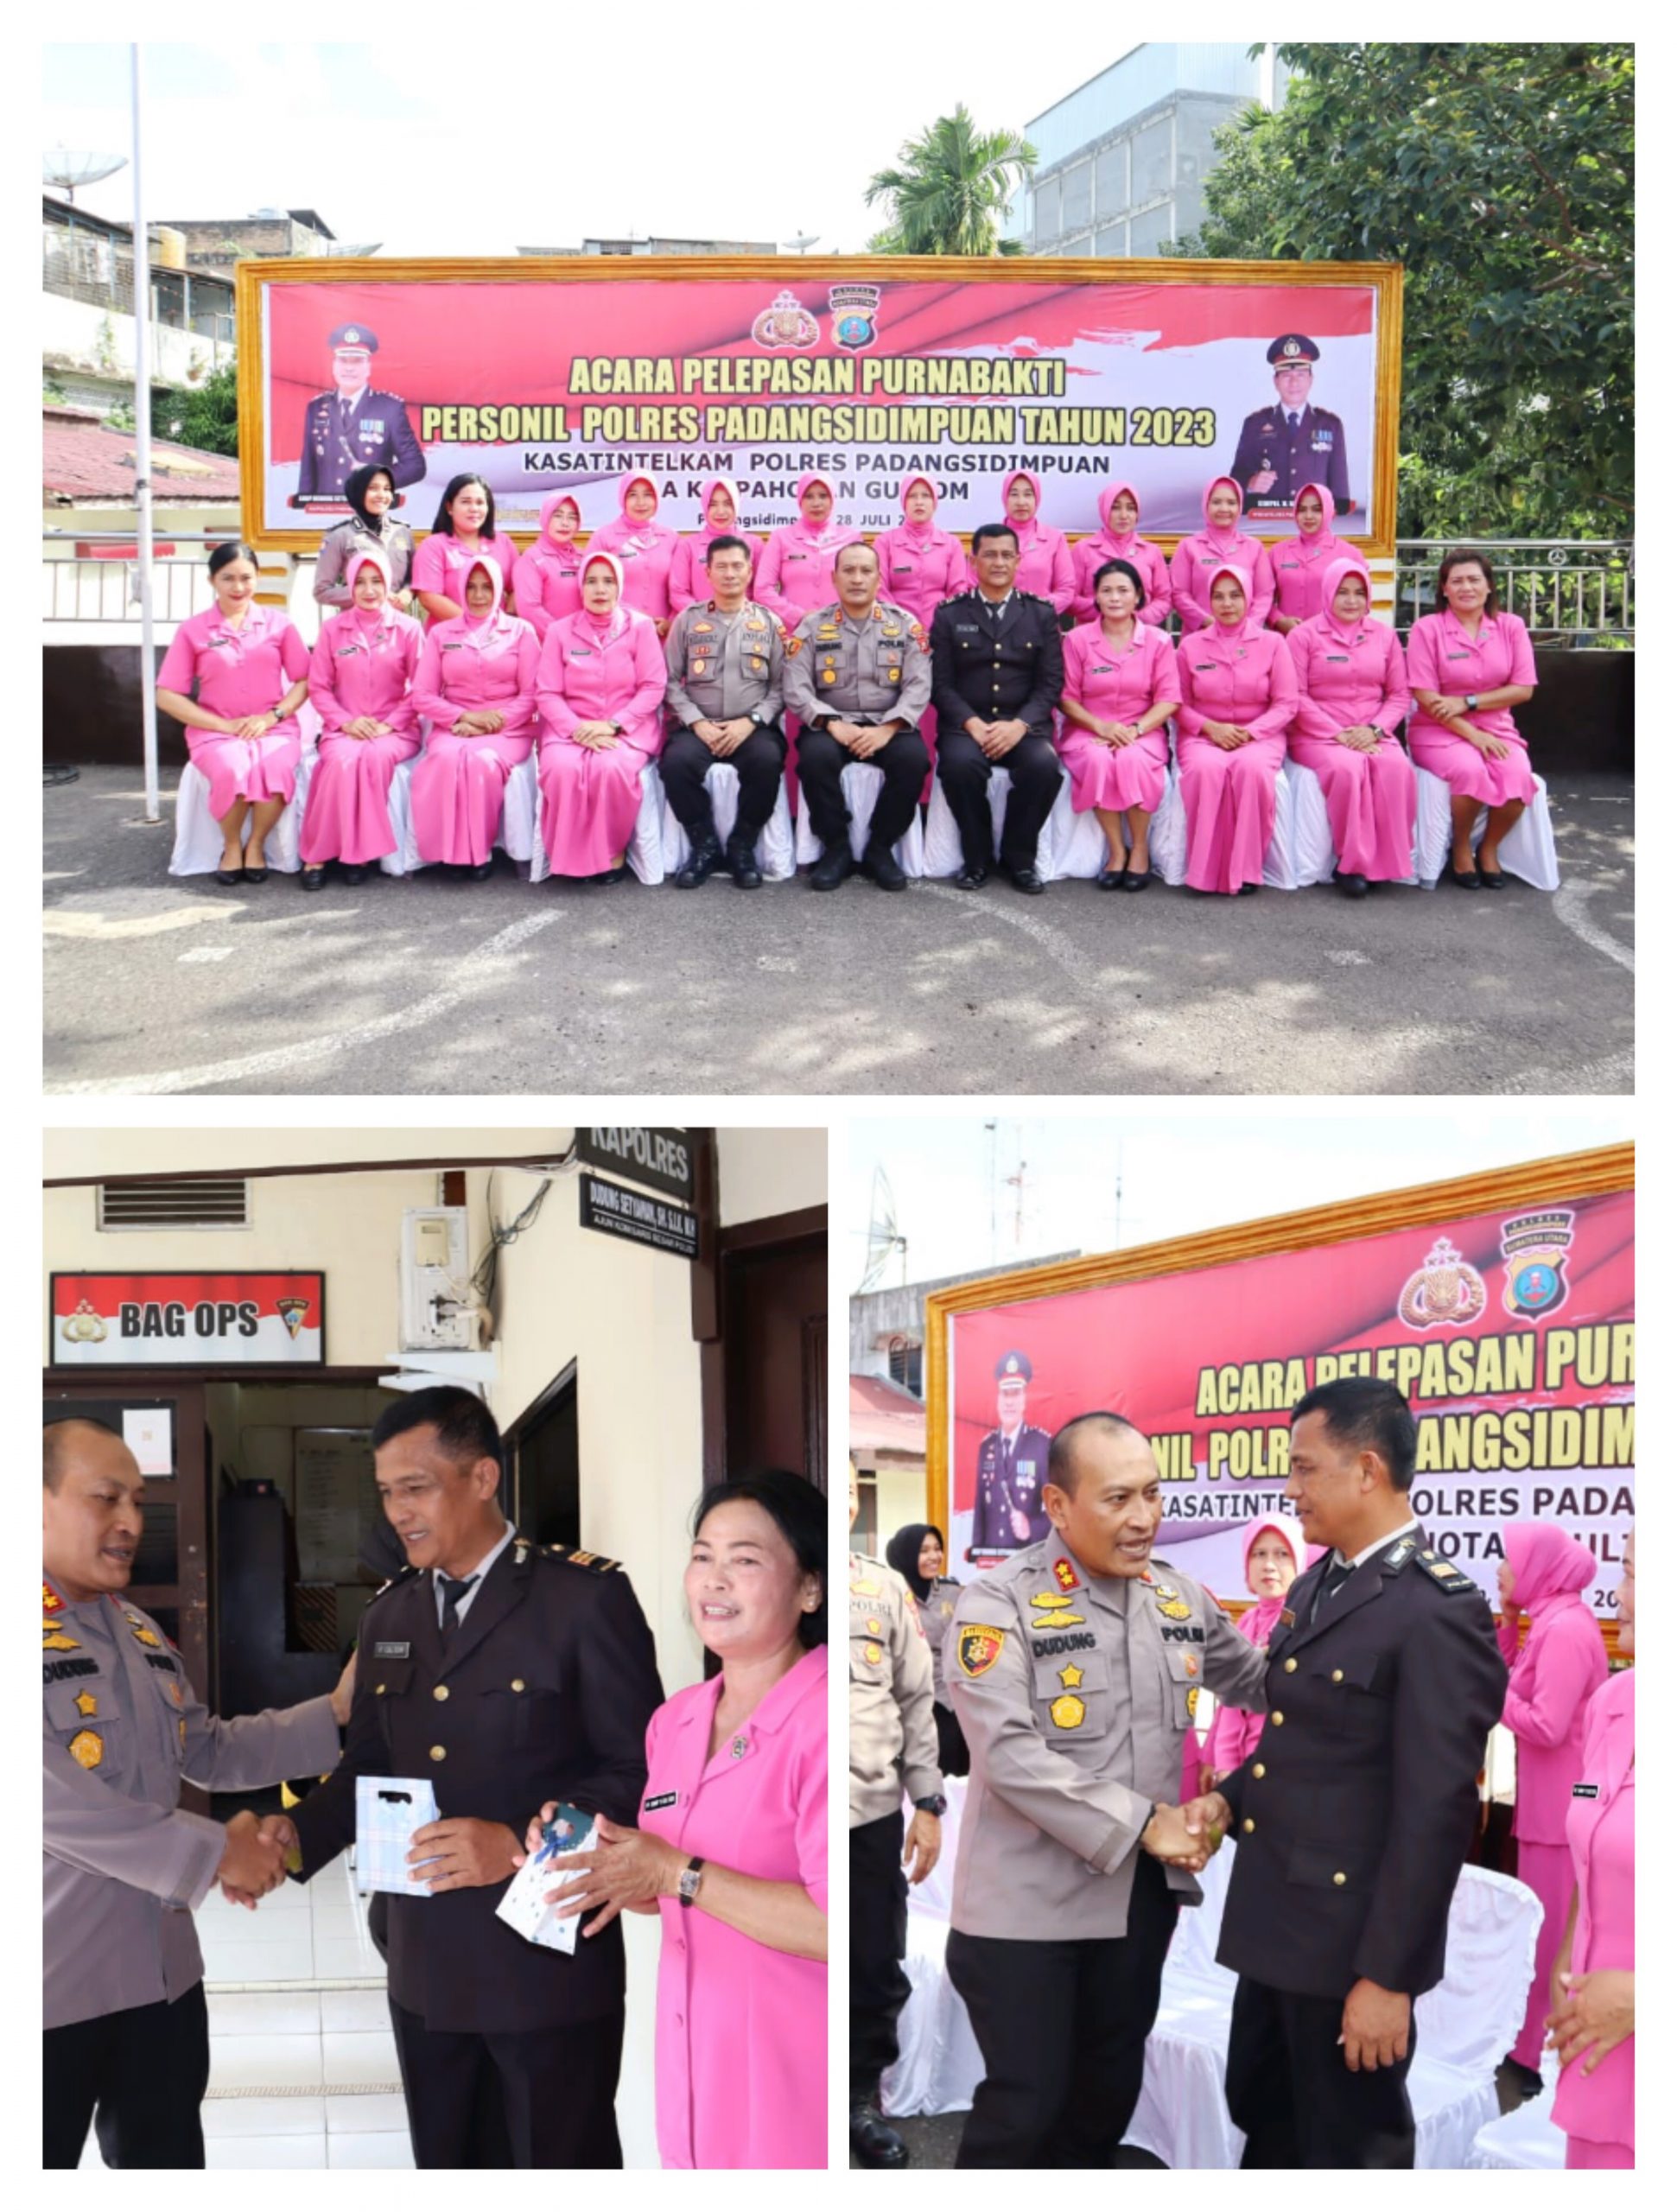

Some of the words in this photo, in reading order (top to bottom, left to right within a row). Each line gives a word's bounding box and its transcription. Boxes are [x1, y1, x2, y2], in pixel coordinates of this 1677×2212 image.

[569, 357, 677, 394] ACARA
[682, 357, 857, 395] PELEPASAN
[861, 358, 1067, 397] PURNABAKTI
[421, 404, 571, 442] PERSONIL
[581, 405, 700, 442] POLRES
[704, 405, 1016, 445] PADANGSIDIMPUAN
[1020, 406, 1127, 446] TAHUN
[1130, 407, 1216, 448] 2023
[524, 452, 733, 471] KASATINTELKAM
[750, 453, 846, 472] POLRES
[855, 454, 1109, 474] PADANGSIDIMPUAN
[737, 480, 854, 499] PAHON
[865, 480, 969, 499] GUOM
[860, 514, 891, 525] JULI
[120, 1302, 187, 1338] BAG
[194, 1301, 258, 1337] OPS
[1195, 1357, 1308, 1417] ACARA
[1207, 1426, 1291, 1481] POLR
[1412, 1488, 1519, 1516] OLRES
[1032, 1632, 1096, 1658] DUDUNG
